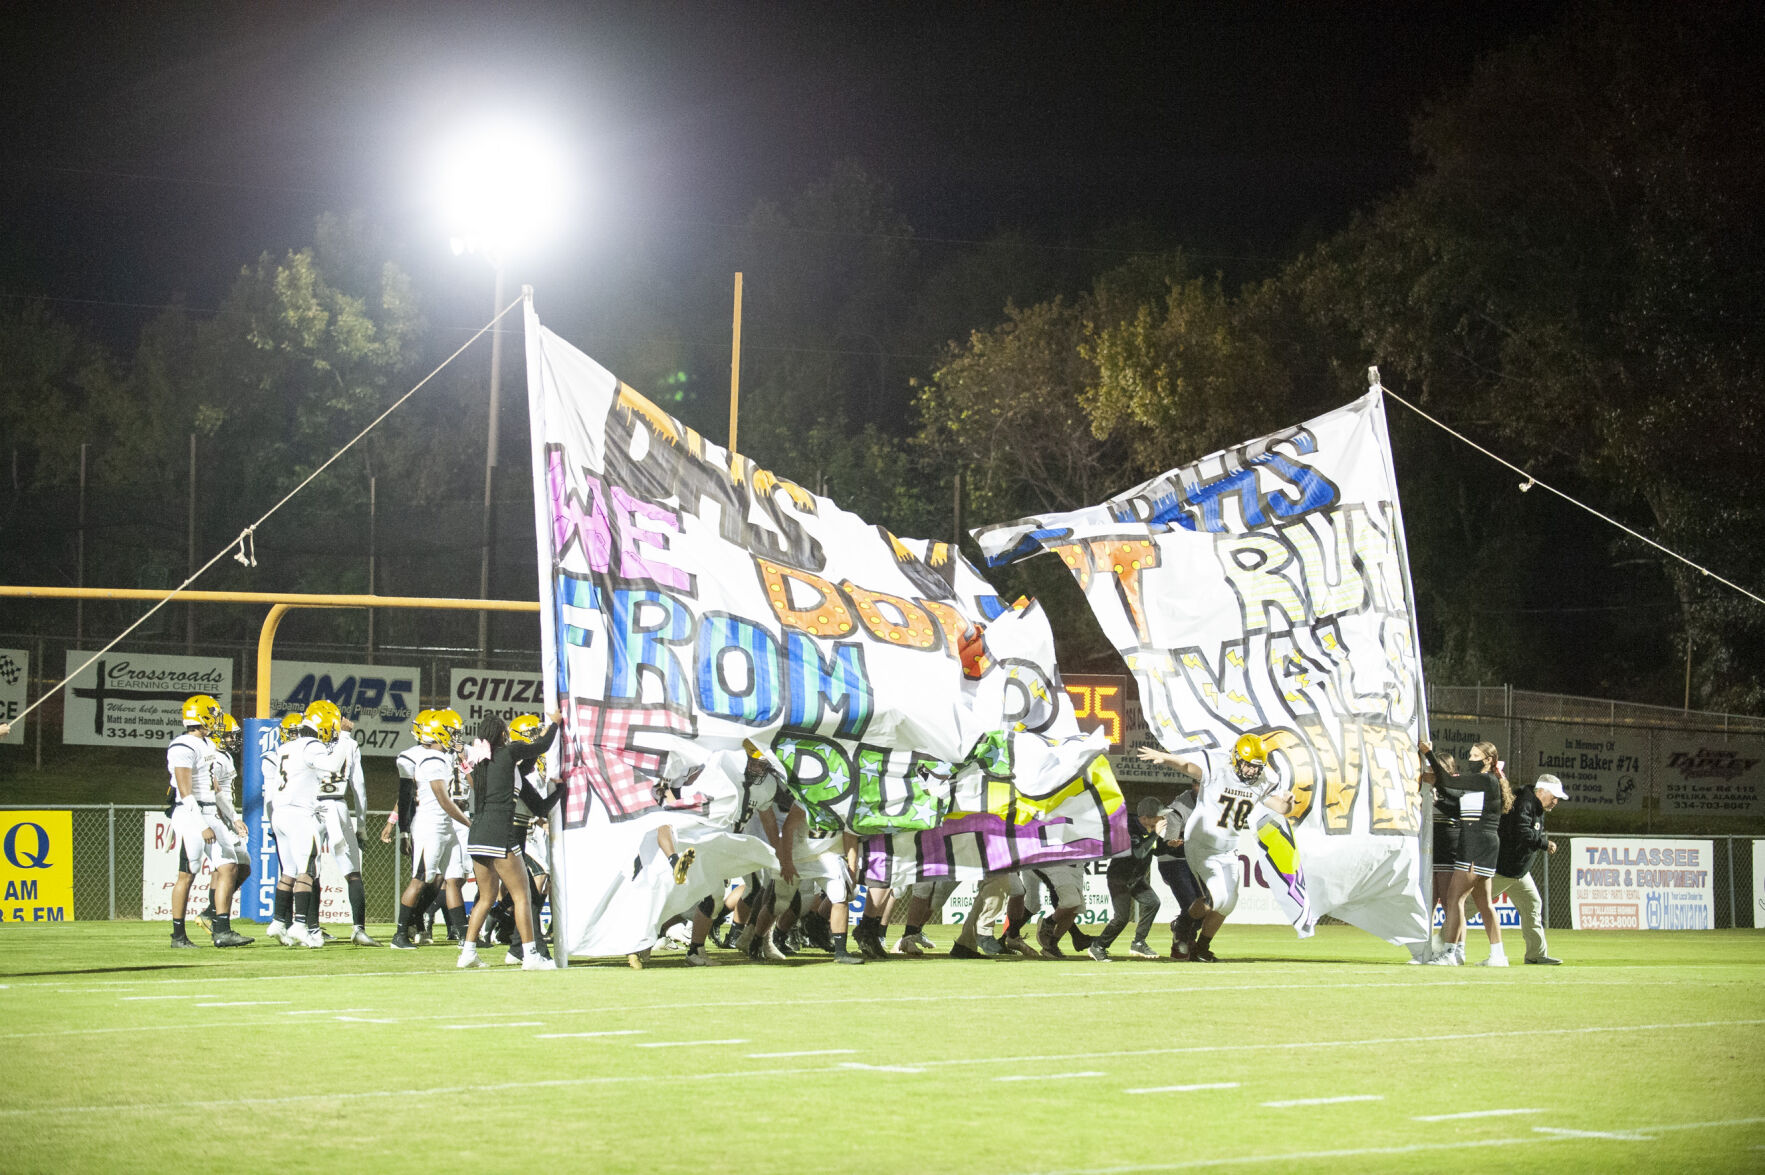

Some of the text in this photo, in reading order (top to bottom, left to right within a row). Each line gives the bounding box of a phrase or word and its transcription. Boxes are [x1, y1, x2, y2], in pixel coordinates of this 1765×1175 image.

[545, 442, 699, 600] WE
[552, 562, 876, 742] FROM
[108, 661, 223, 683] Crossroads
[110, 680, 219, 691] LEARNING CENTER
[274, 673, 412, 722] AMPS
[107, 703, 136, 713] Where
[139, 704, 158, 715] help
[354, 705, 378, 718] Pump
[380, 705, 412, 718] Service
[107, 714, 122, 724] Matt
[124, 716, 136, 724] and
[138, 716, 164, 726] Hannah
[1443, 728, 1481, 743] Alabama
[1575, 739, 1604, 752] Memory
[1539, 751, 1640, 773] Lanier Baker #74
[1712, 793, 1758, 801] ALABAMA
[1216, 794, 1255, 831] 70
[4, 822, 54, 869] Q
[1586, 847, 1699, 866] TALLASSEE
[1577, 868, 1708, 888] POWER & EQUIPMENT
[4, 880, 38, 900] AM
[1088, 894, 1109, 905] STRAW
[1663, 892, 1708, 930] Husqvarna
[1581, 916, 1637, 929] 334-283-8000
